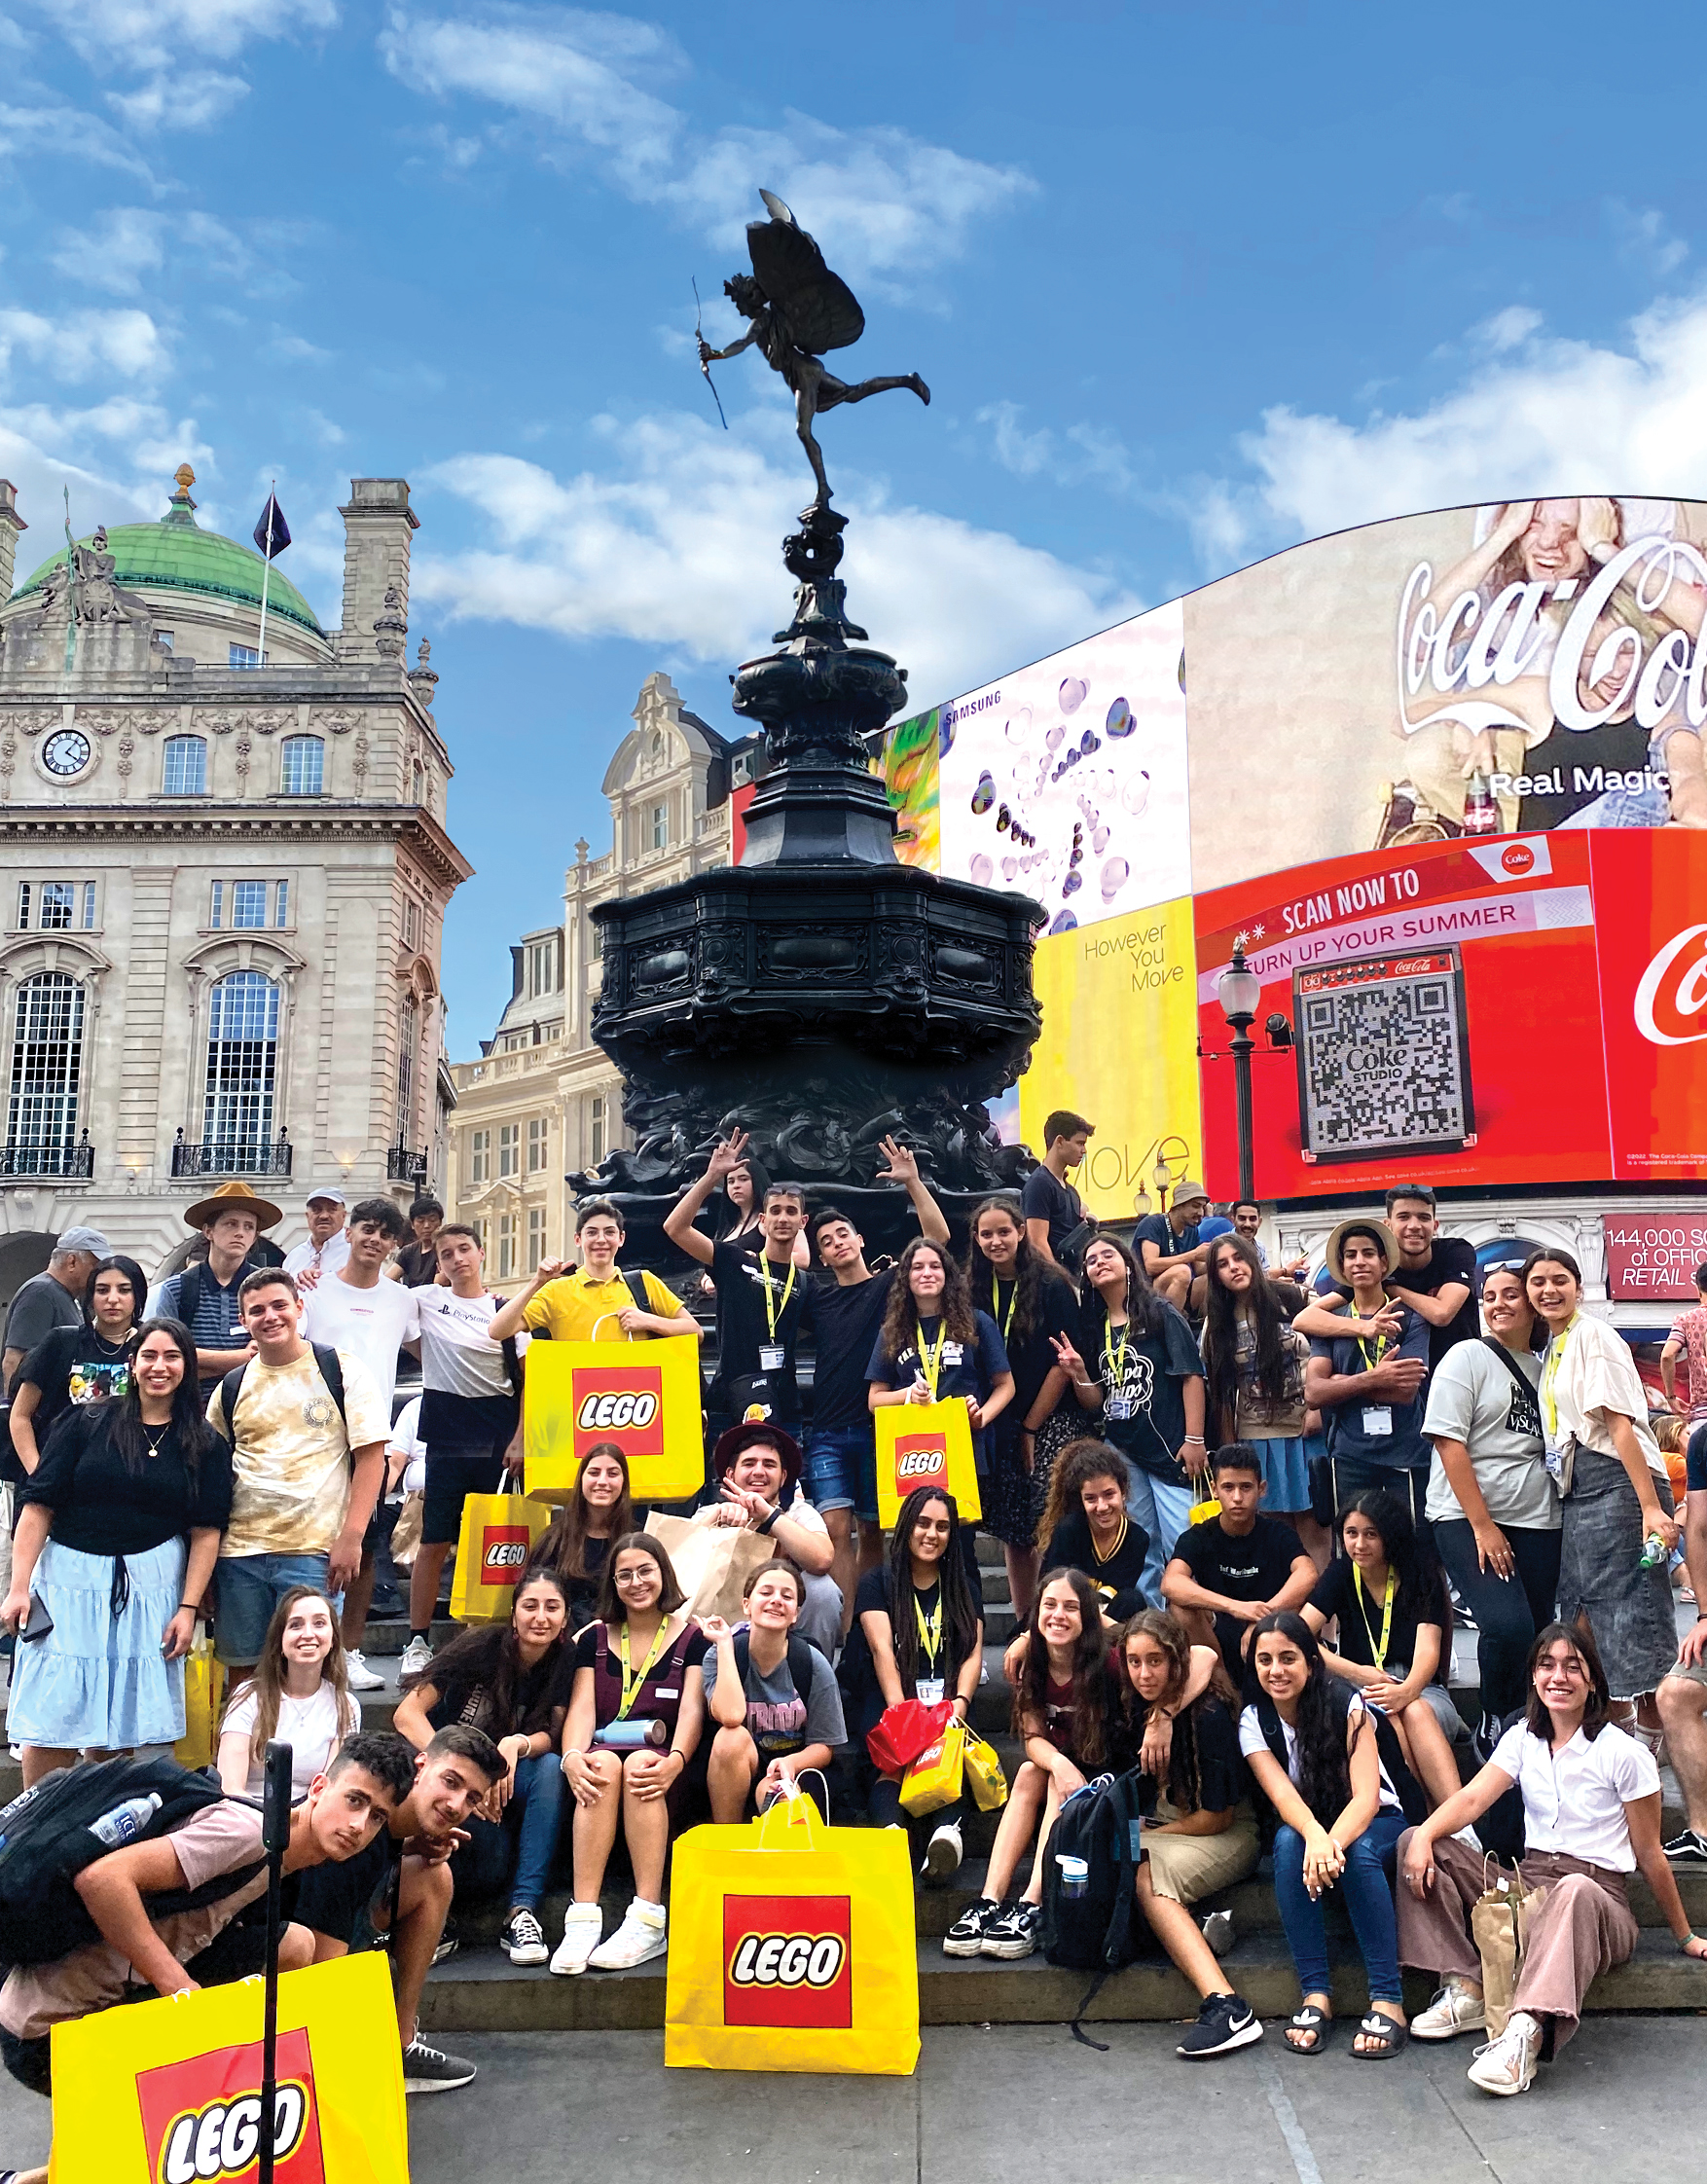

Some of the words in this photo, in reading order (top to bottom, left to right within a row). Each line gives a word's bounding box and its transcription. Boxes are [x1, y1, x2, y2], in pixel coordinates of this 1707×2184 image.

[945, 690, 1001, 726] SAMSUNG
[1489, 767, 1564, 798] Real
[1574, 764, 1671, 797] Magic
[1505, 853, 1530, 865] Coke
[1281, 892, 1332, 934] SCAN
[1335, 876, 1385, 918] NOW
[1389, 869, 1420, 901] TO
[1084, 924, 1167, 961] However
[1244, 950, 1292, 975] TURN
[1299, 940, 1326, 963] UP
[1330, 925, 1395, 955] YOUR
[1401, 904, 1517, 938] SUMMER
[1130, 947, 1165, 969] You
[1132, 965, 1184, 993] Move
[1346, 1047, 1408, 1072] Coke
[1353, 1068, 1403, 1083] STUDIO
[125, 1185, 208, 1196] ALLIANCE
[1607, 1228, 1686, 1249] 144,000
[1631, 1249, 1649, 1266] of
[1621, 1268, 1687, 1286] RETAIL
[579, 1394, 657, 1429] LEGO
[898, 1451, 944, 1477] LEGO
[486, 1544, 527, 1566] LEGO
[120, 1815, 136, 1838] ICE
[733, 1936, 843, 1985] LEGO
[165, 2086, 304, 2184] LEGO
